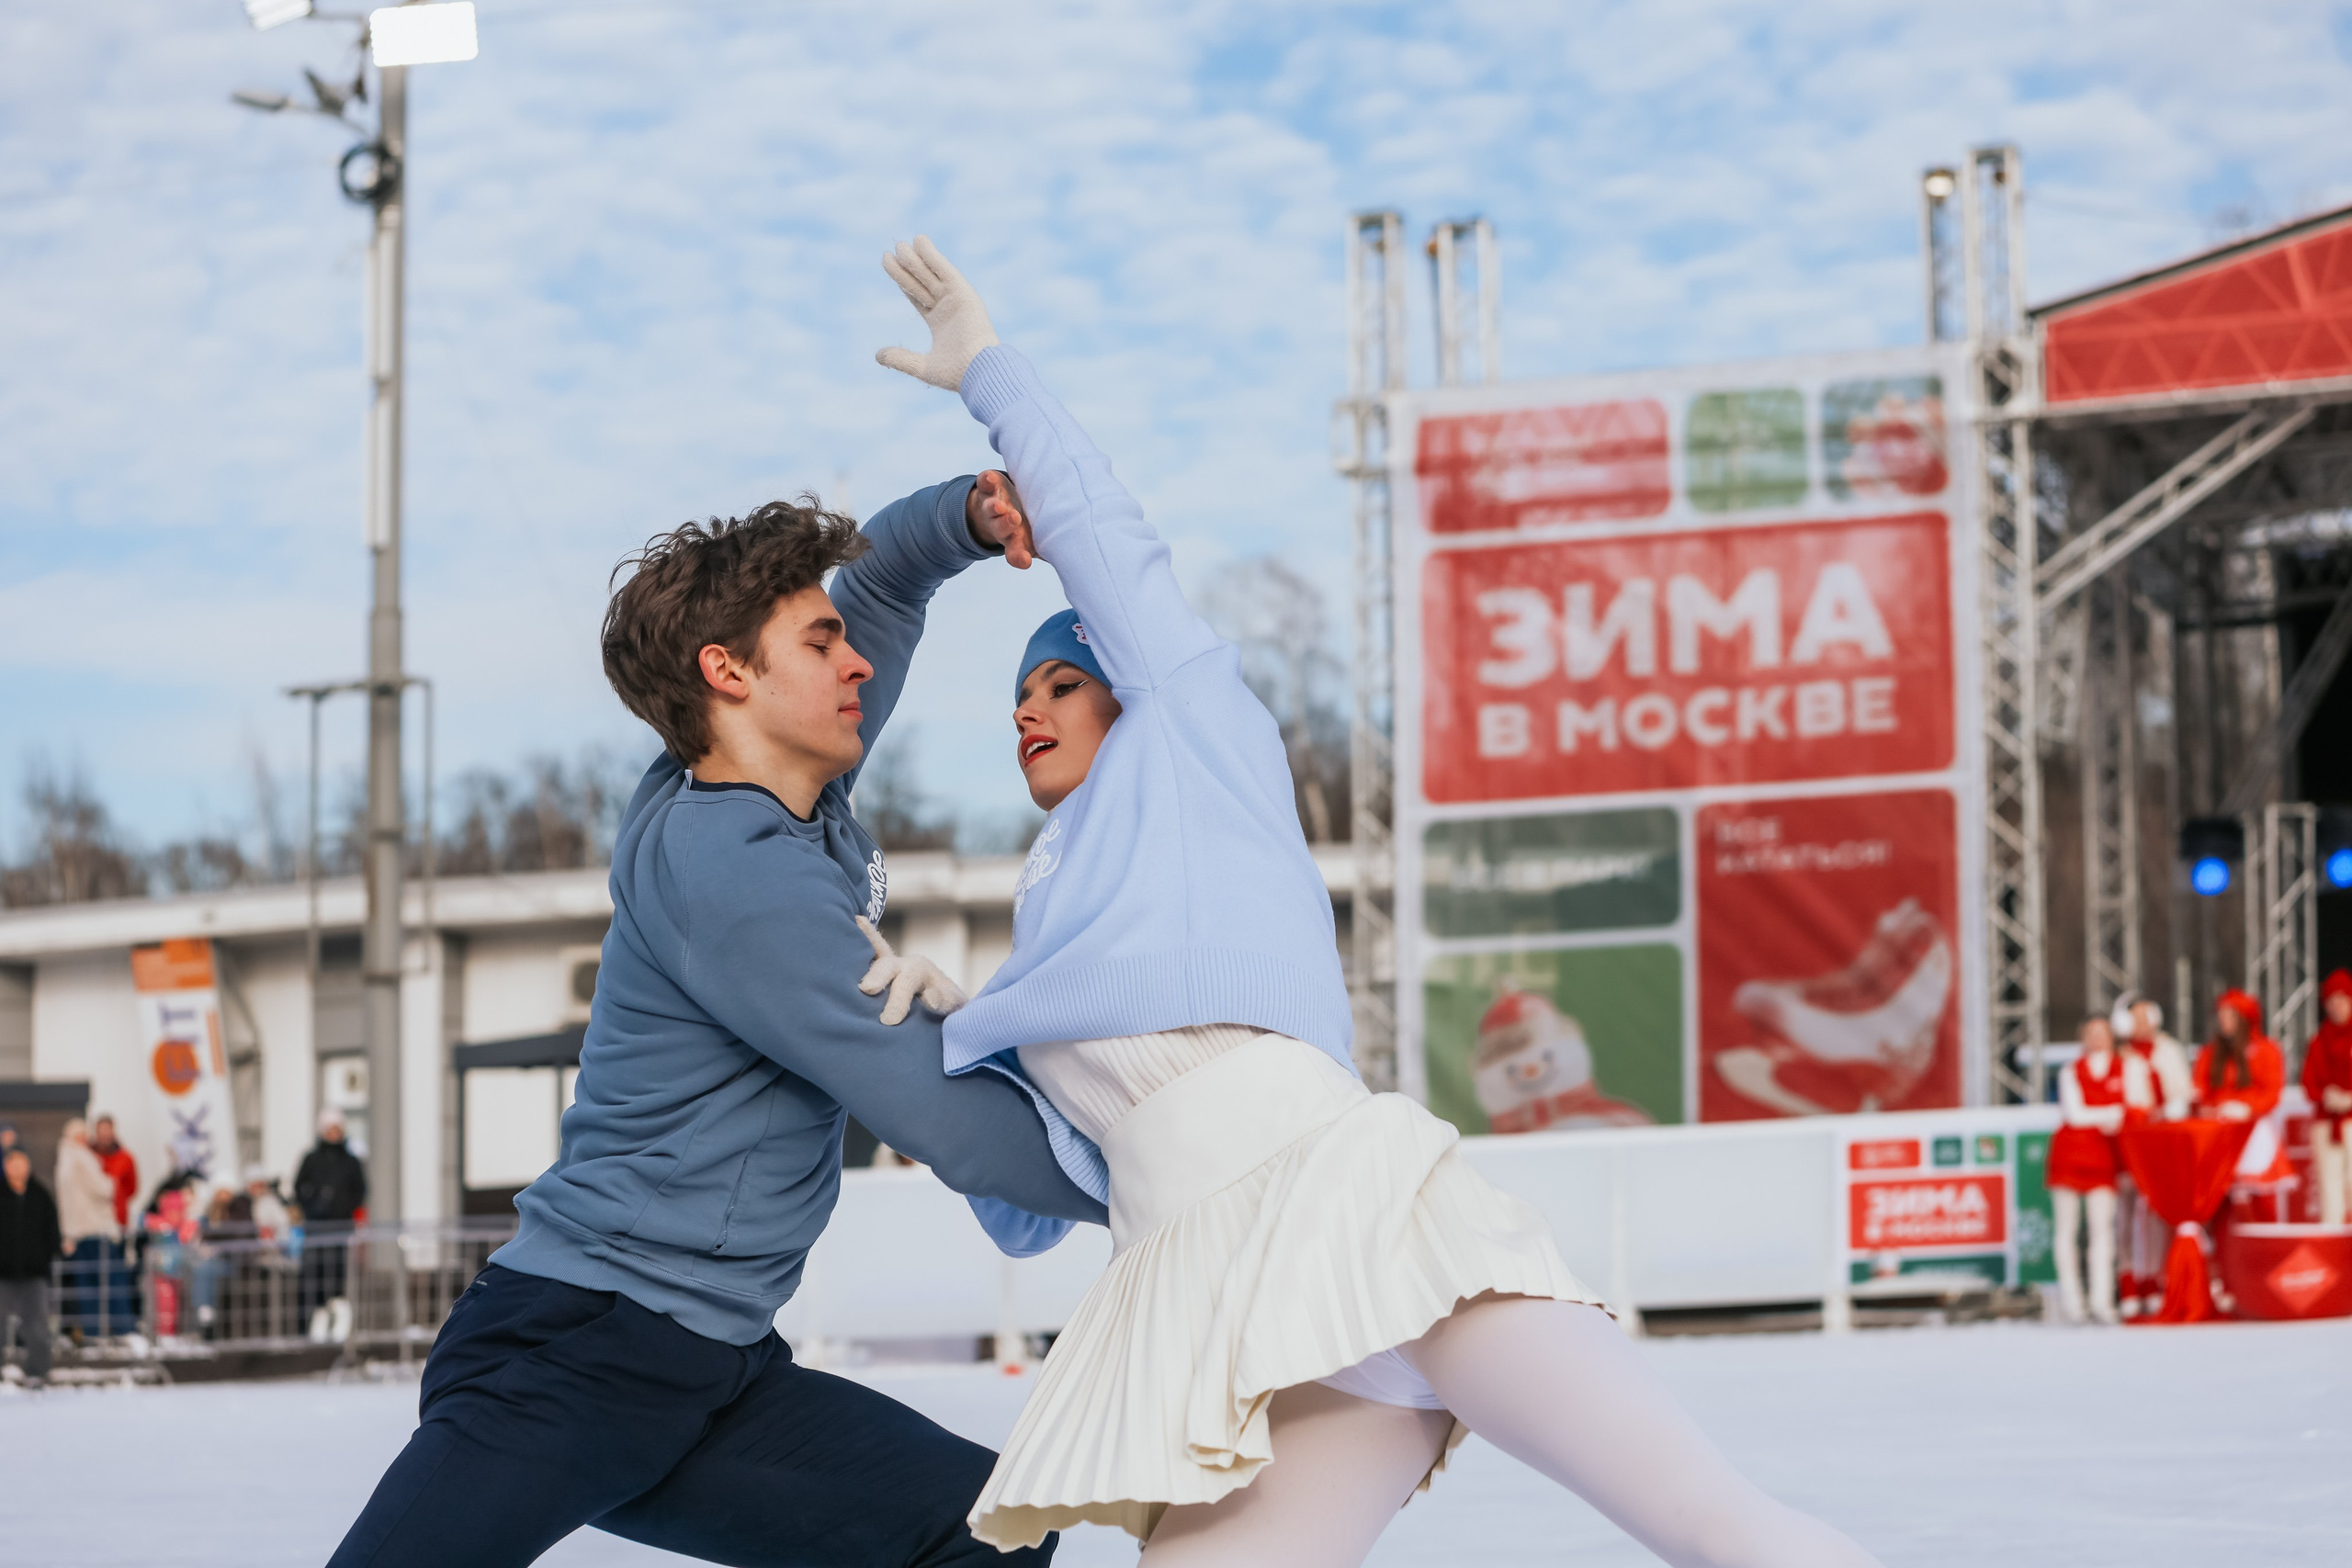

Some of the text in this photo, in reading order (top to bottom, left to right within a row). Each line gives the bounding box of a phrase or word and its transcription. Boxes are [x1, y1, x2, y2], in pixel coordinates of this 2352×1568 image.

[1476, 563, 1894, 689] ЗИМА
[1477, 677, 1898, 759] В МОСКВЕ
[1866, 1183, 1989, 1220] ЗИМА
